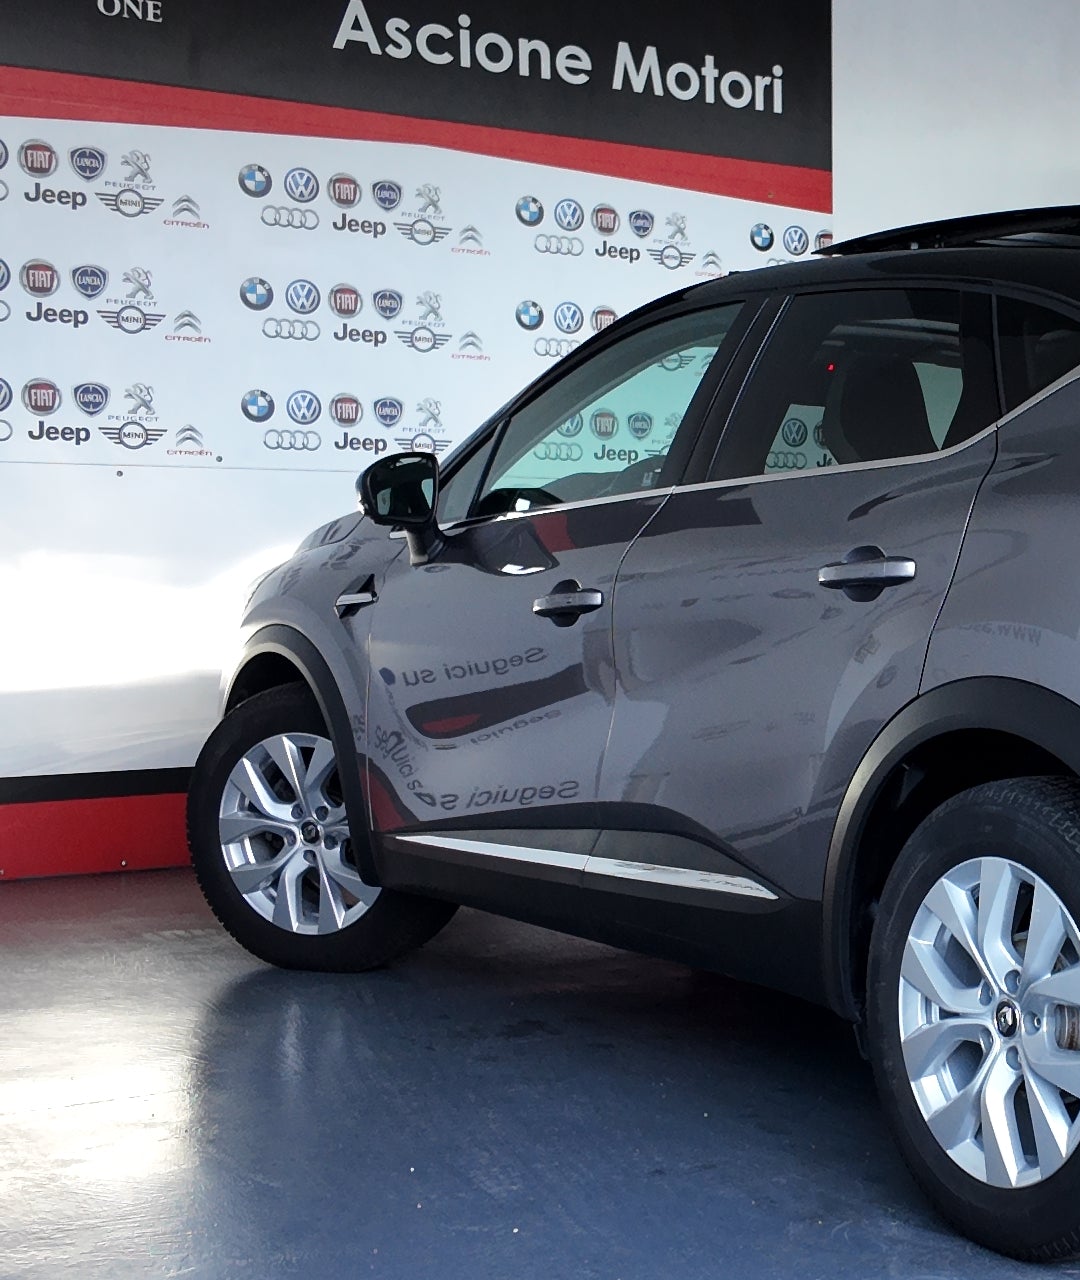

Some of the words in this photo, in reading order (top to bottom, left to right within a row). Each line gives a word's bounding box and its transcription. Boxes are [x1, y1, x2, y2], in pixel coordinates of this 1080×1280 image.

[612, 41, 783, 114] Motori
[26, 149, 51, 169] FIAT
[24, 182, 88, 210] Jeep
[335, 183, 356, 201] FIAT
[332, 213, 387, 238] Jeep
[595, 240, 641, 263] Jeep
[28, 270, 53, 288] FIAT
[335, 294, 357, 311] FIAT
[25, 302, 89, 328] Jeep
[333, 323, 387, 347] Jeep
[30, 388, 55, 407] FIAT
[337, 402, 358, 419] FIAT
[27, 421, 91, 445] Jeep
[334, 432, 388, 455] Jeep
[593, 444, 639, 464] Jeep
